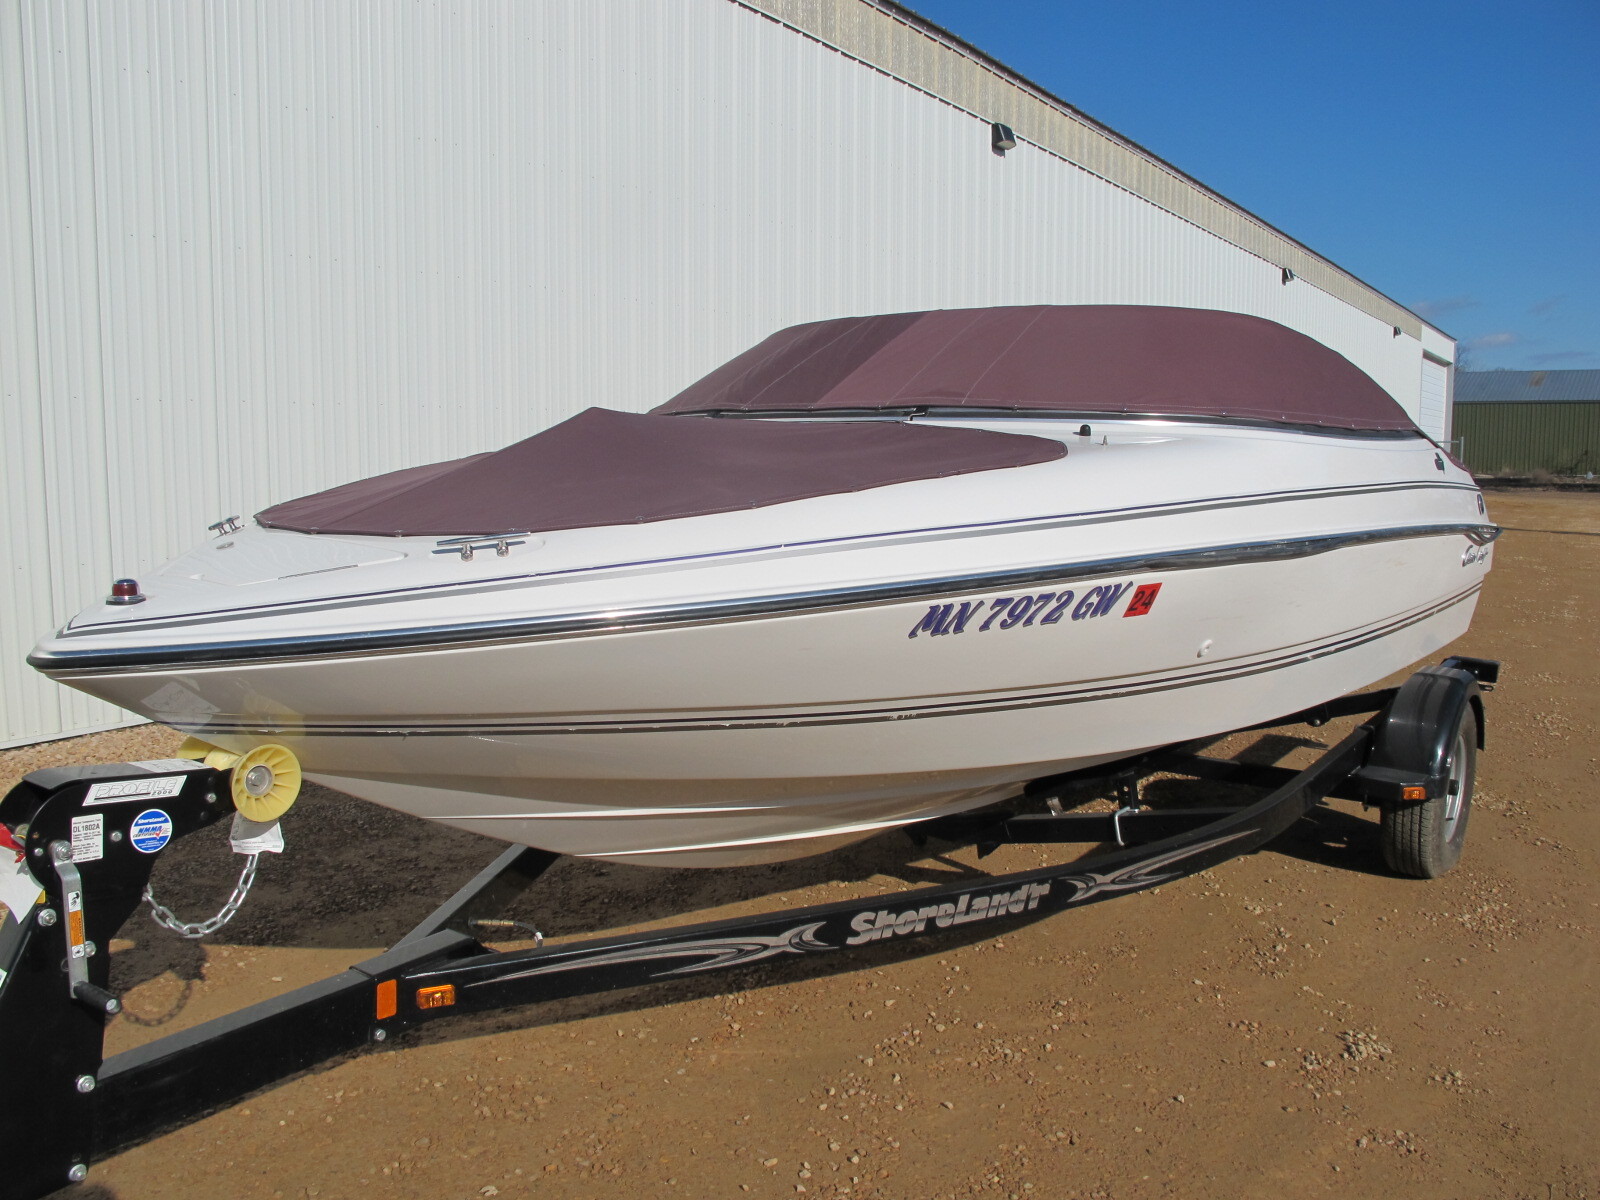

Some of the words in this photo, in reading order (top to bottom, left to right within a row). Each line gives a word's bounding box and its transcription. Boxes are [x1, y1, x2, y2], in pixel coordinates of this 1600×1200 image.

[908, 600, 985, 640] MN
[978, 589, 1075, 633] 7972
[1071, 581, 1134, 622] GW
[1129, 588, 1155, 613] 24
[95, 778, 178, 798] PROFILE
